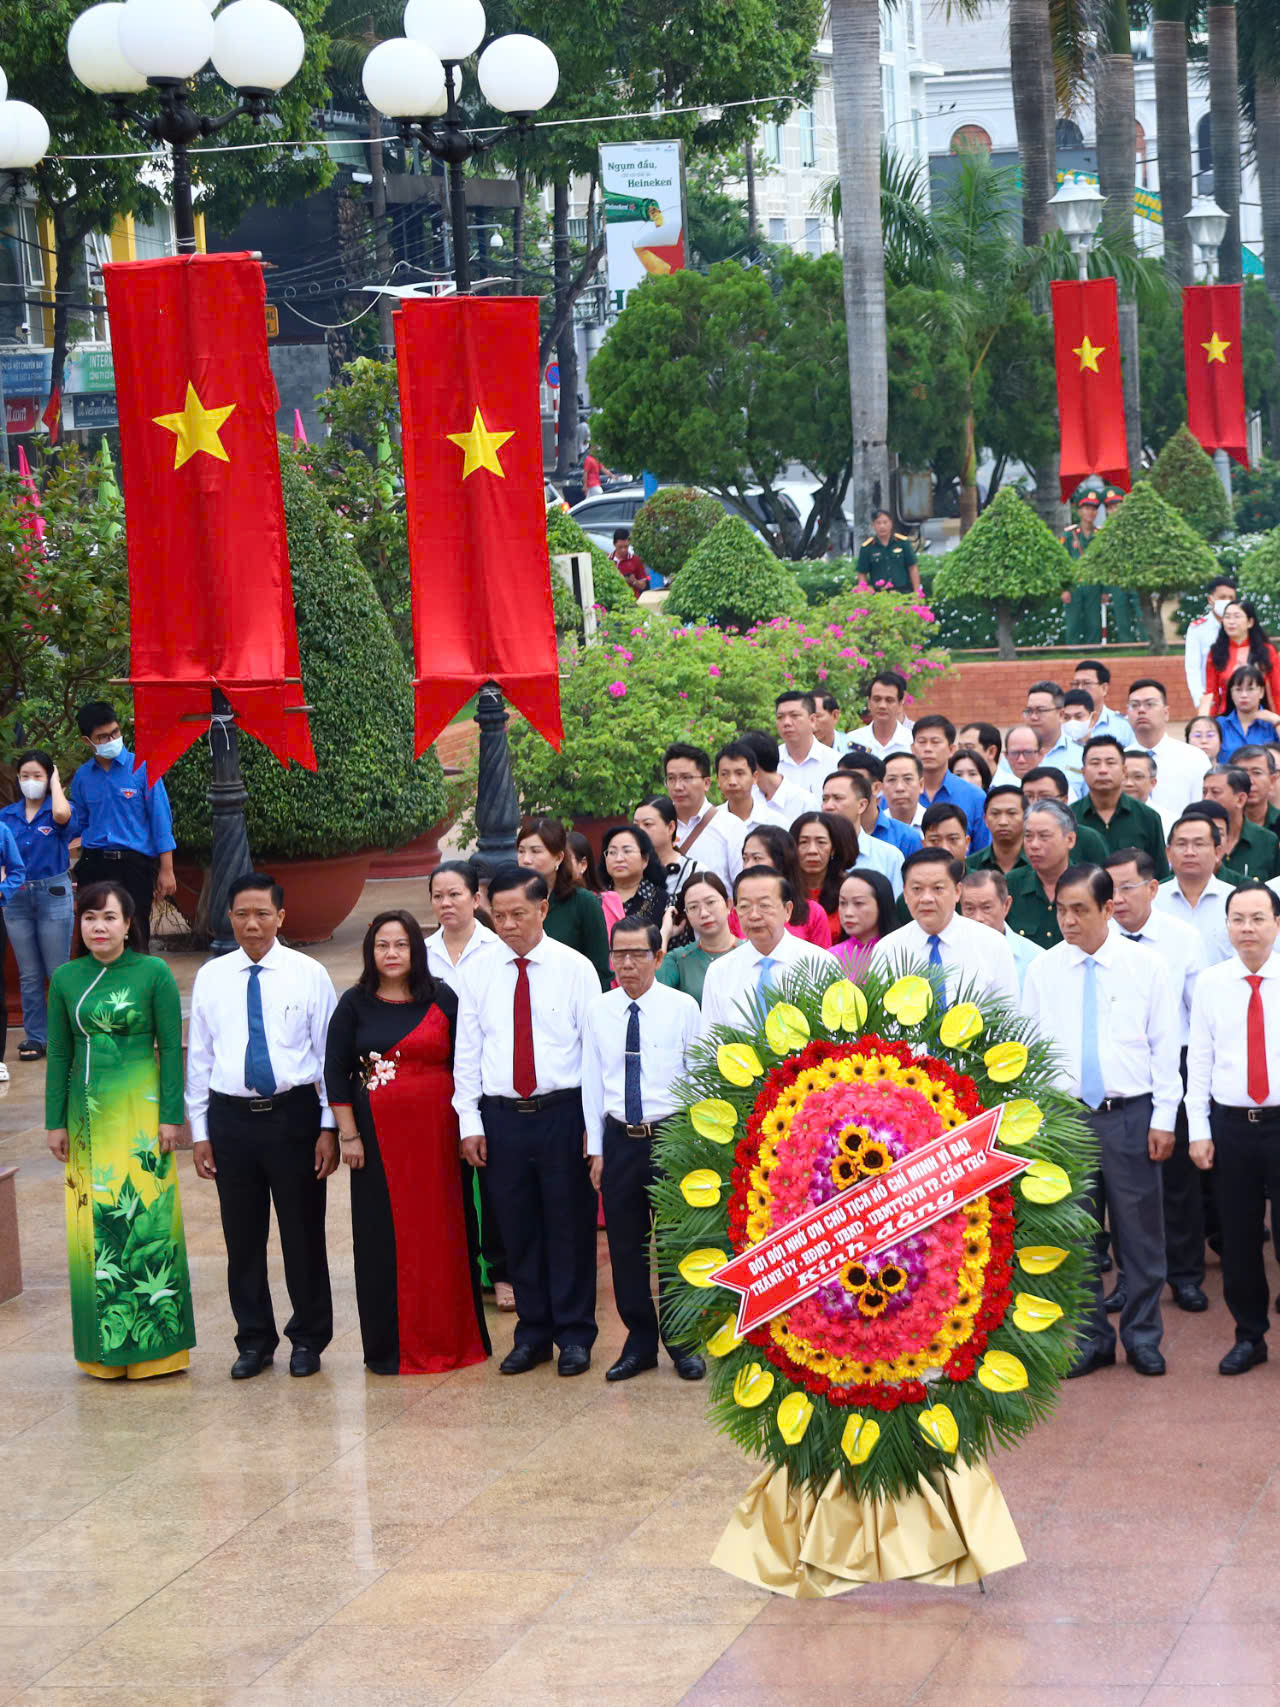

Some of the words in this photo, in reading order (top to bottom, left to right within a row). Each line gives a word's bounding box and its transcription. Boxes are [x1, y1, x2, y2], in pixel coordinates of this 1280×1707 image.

[608, 161, 635, 172] Ngụm
[628, 177, 672, 188] Heineken
[749, 1272, 785, 1296] THÀNH
[782, 1259, 799, 1277] ỦY
[800, 1239, 831, 1265] HĐND
[833, 1220, 865, 1245] UBND
[867, 1185, 927, 1226] UBMTTQVN
[924, 1177, 943, 1194] TP.
[940, 1162, 966, 1185] CẦN
[963, 1150, 988, 1173] THƠ
[784, 1229, 808, 1253] NHỚ
[807, 1221, 825, 1239] ƠN
[823, 1204, 847, 1229] CHỦ
[844, 1192, 872, 1217] TỊCH
[870, 1178, 888, 1202] HỒ
[887, 1169, 909, 1192] CHÍ
[906, 1155, 939, 1182] MINH
[936, 1144, 952, 1164] VĨ
[949, 1136, 972, 1158] ĐẠI
[796, 1240, 868, 1288] Kính
[875, 1189, 955, 1240] dâng
